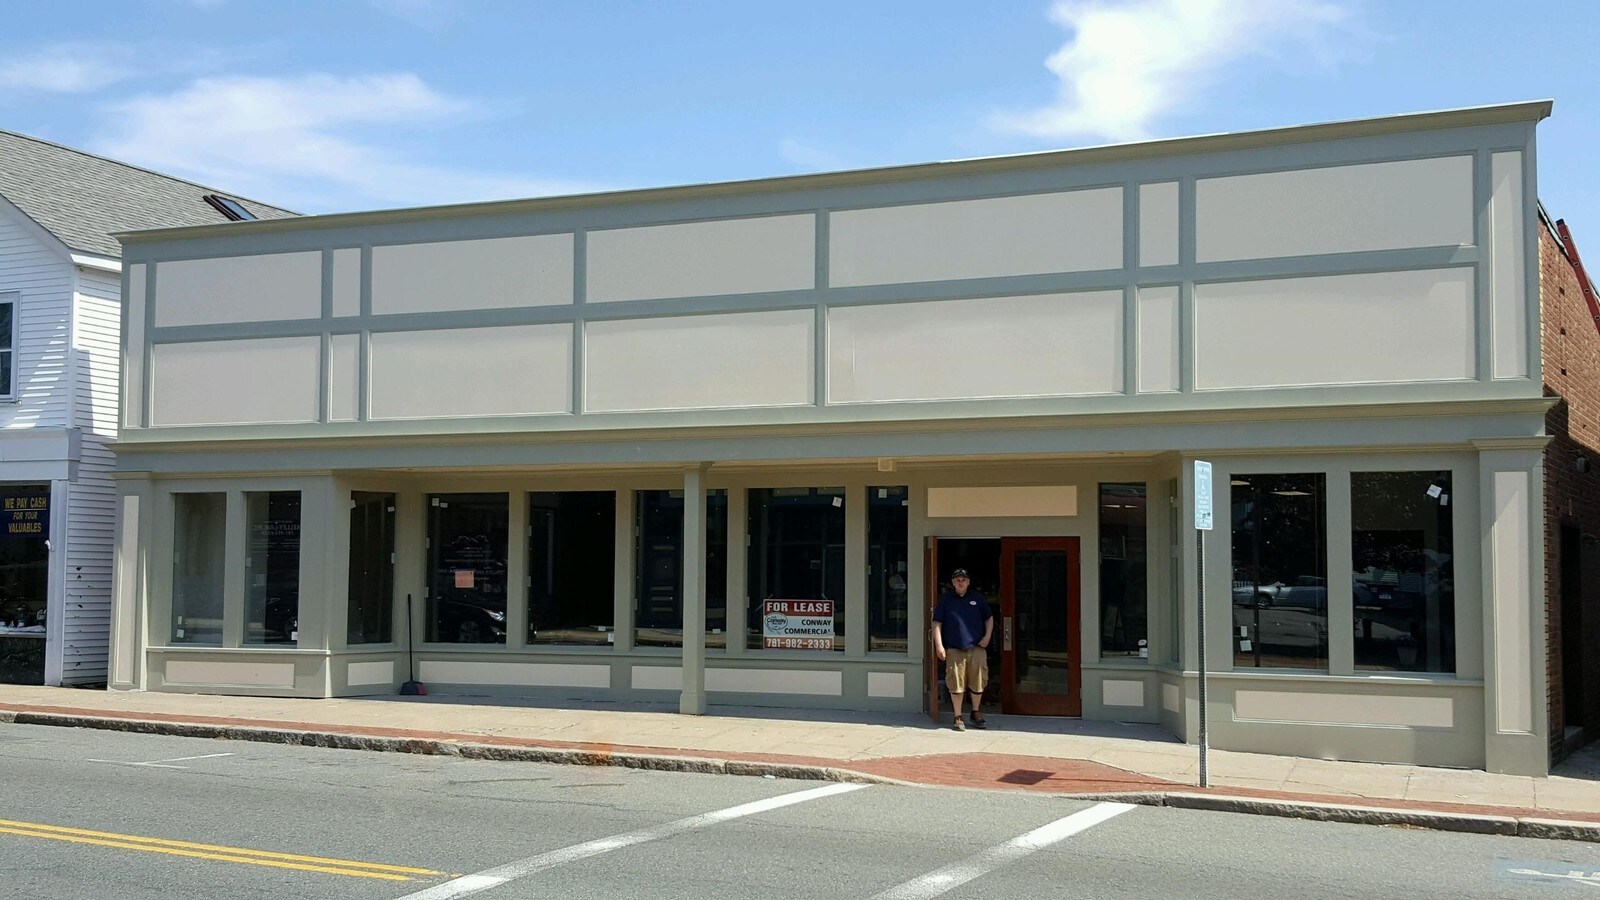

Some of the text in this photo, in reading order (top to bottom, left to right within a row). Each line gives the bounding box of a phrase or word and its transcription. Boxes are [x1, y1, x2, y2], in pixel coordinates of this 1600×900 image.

[4, 497, 47, 509] WE PAY CASH
[13, 511, 38, 520] FOR YOUR
[8, 522, 42, 533] VALUABLES
[766, 602, 830, 612] FOR LEASE
[766, 638, 831, 648] 781-982-2333
